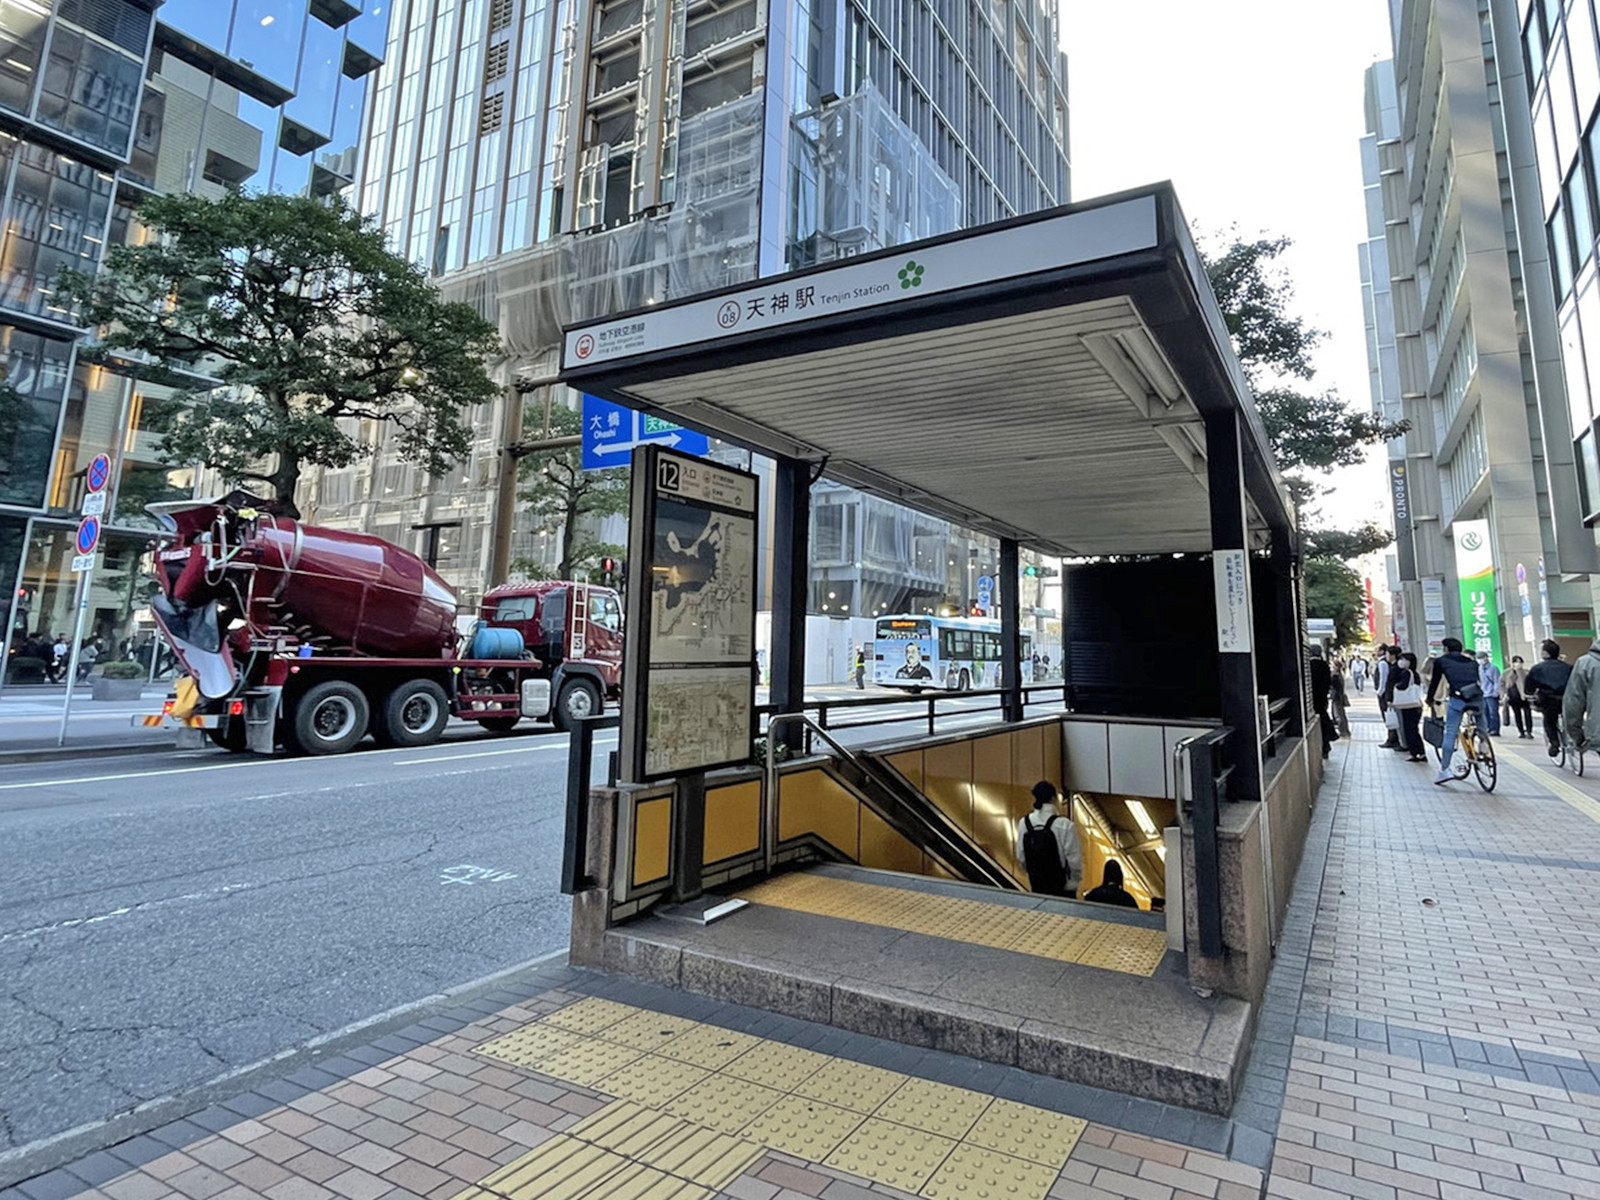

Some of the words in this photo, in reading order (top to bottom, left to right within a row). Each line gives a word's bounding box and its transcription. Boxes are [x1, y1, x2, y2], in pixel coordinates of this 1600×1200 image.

[746, 286, 815, 320] 天神駅
[820, 292, 850, 304] Tenjin
[853, 283, 890, 299] Station
[726, 304, 733, 312] K
[721, 312, 736, 325] 08
[590, 411, 620, 430] 大橋
[593, 428, 617, 439] Ohashi
[660, 462, 679, 488] 12
[1394, 479, 1407, 519] PRONTO
